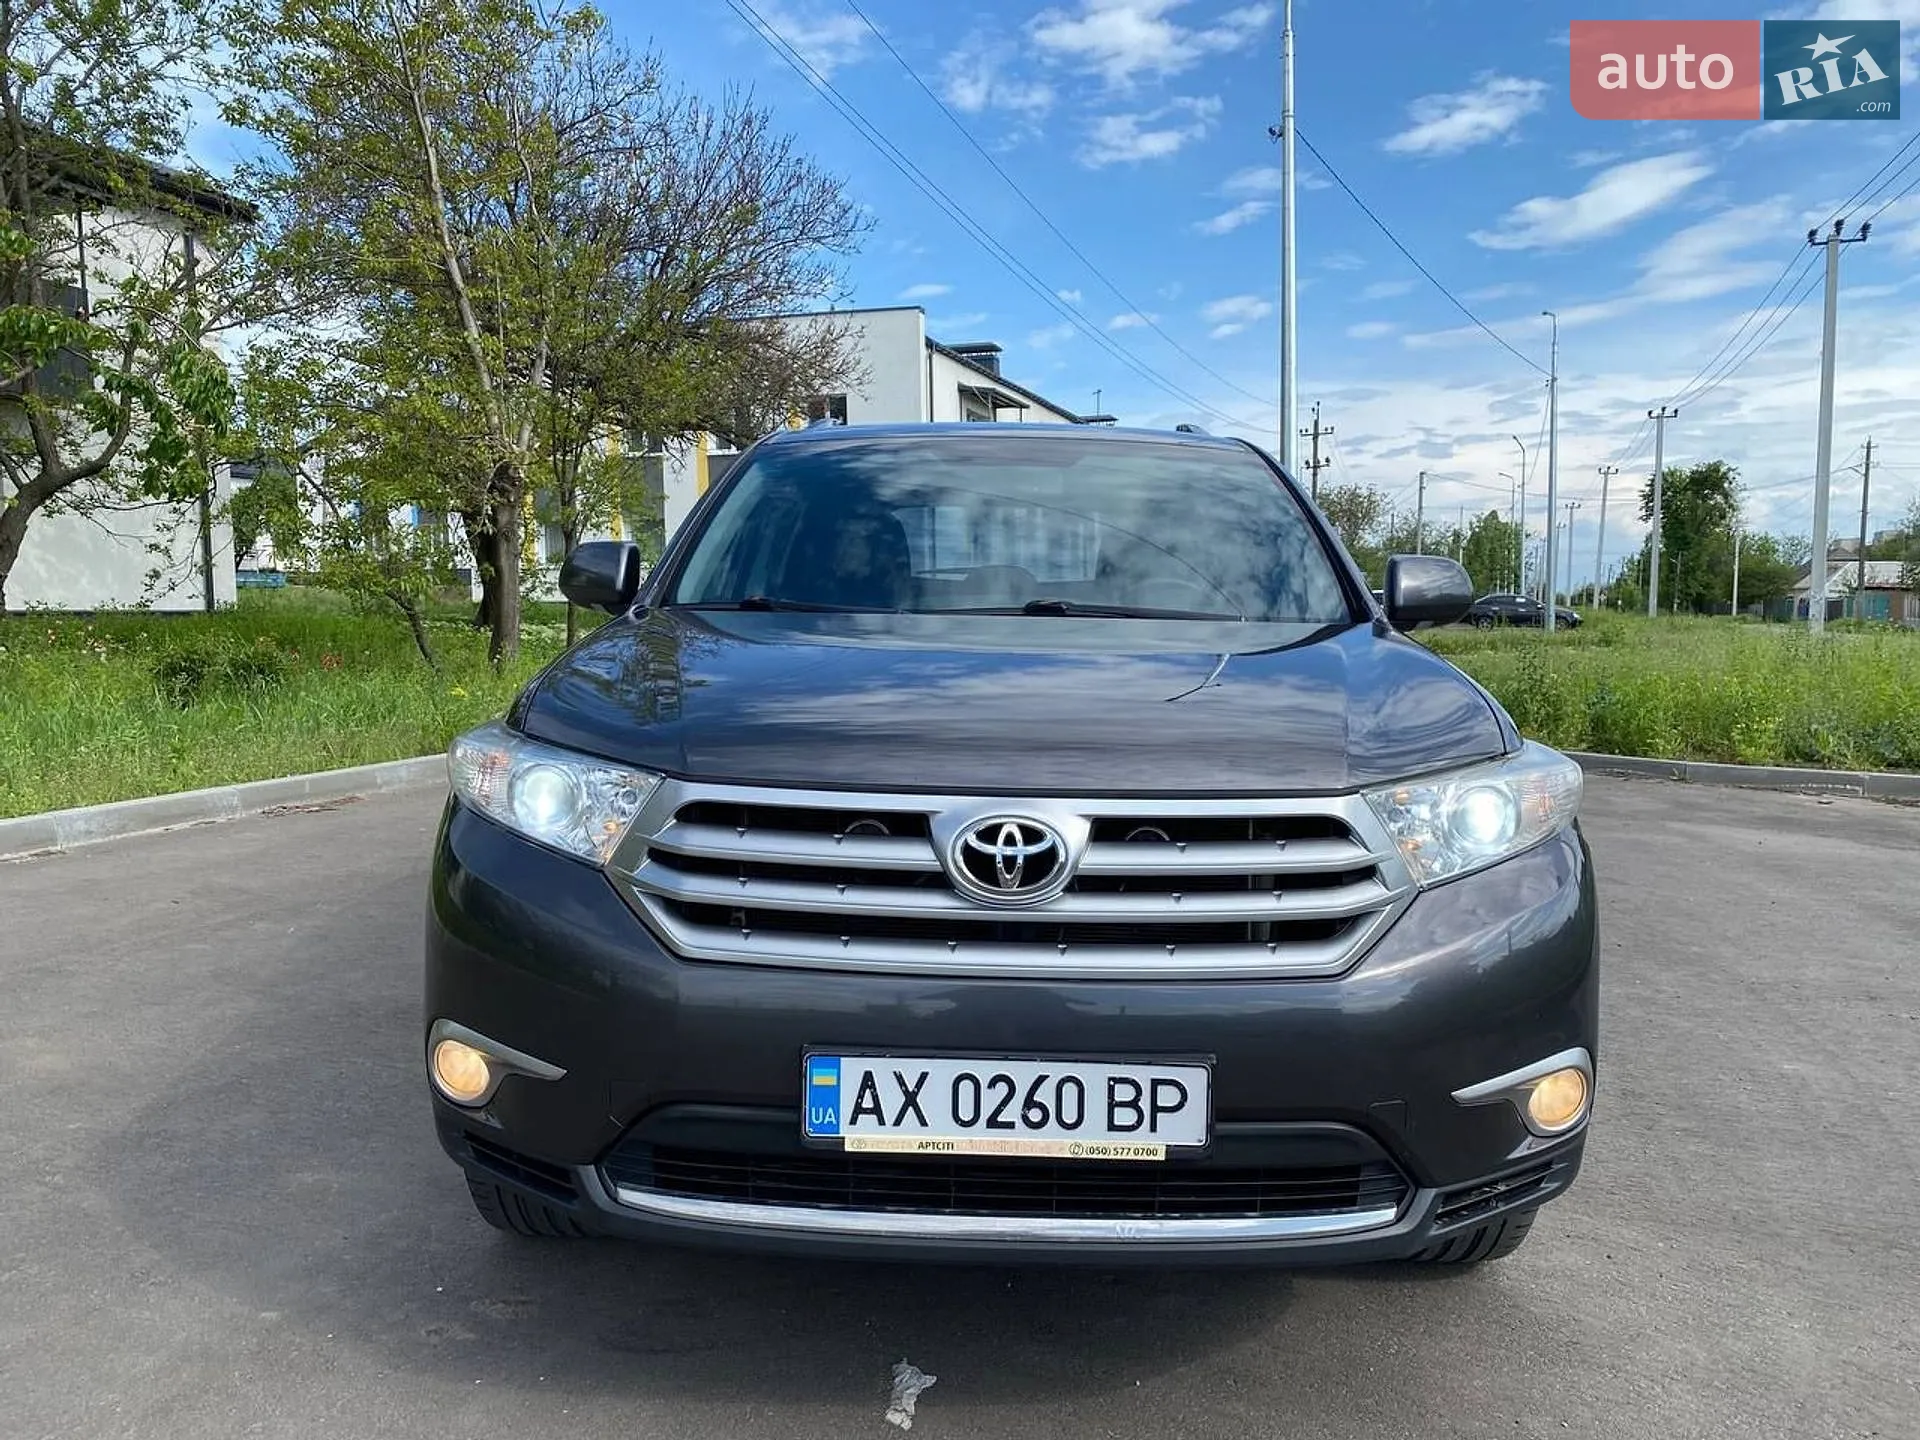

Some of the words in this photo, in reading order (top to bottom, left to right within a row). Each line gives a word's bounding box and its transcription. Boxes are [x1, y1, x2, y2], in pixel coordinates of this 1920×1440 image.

[849, 1069, 930, 1128] AX
[951, 1072, 1086, 1131] 0260
[1107, 1076, 1189, 1134] BP
[811, 1106, 837, 1125] UA
[1085, 1145, 1111, 1156] (050)
[1113, 1147, 1131, 1157] 577
[1134, 1147, 1158, 1157] 0700
